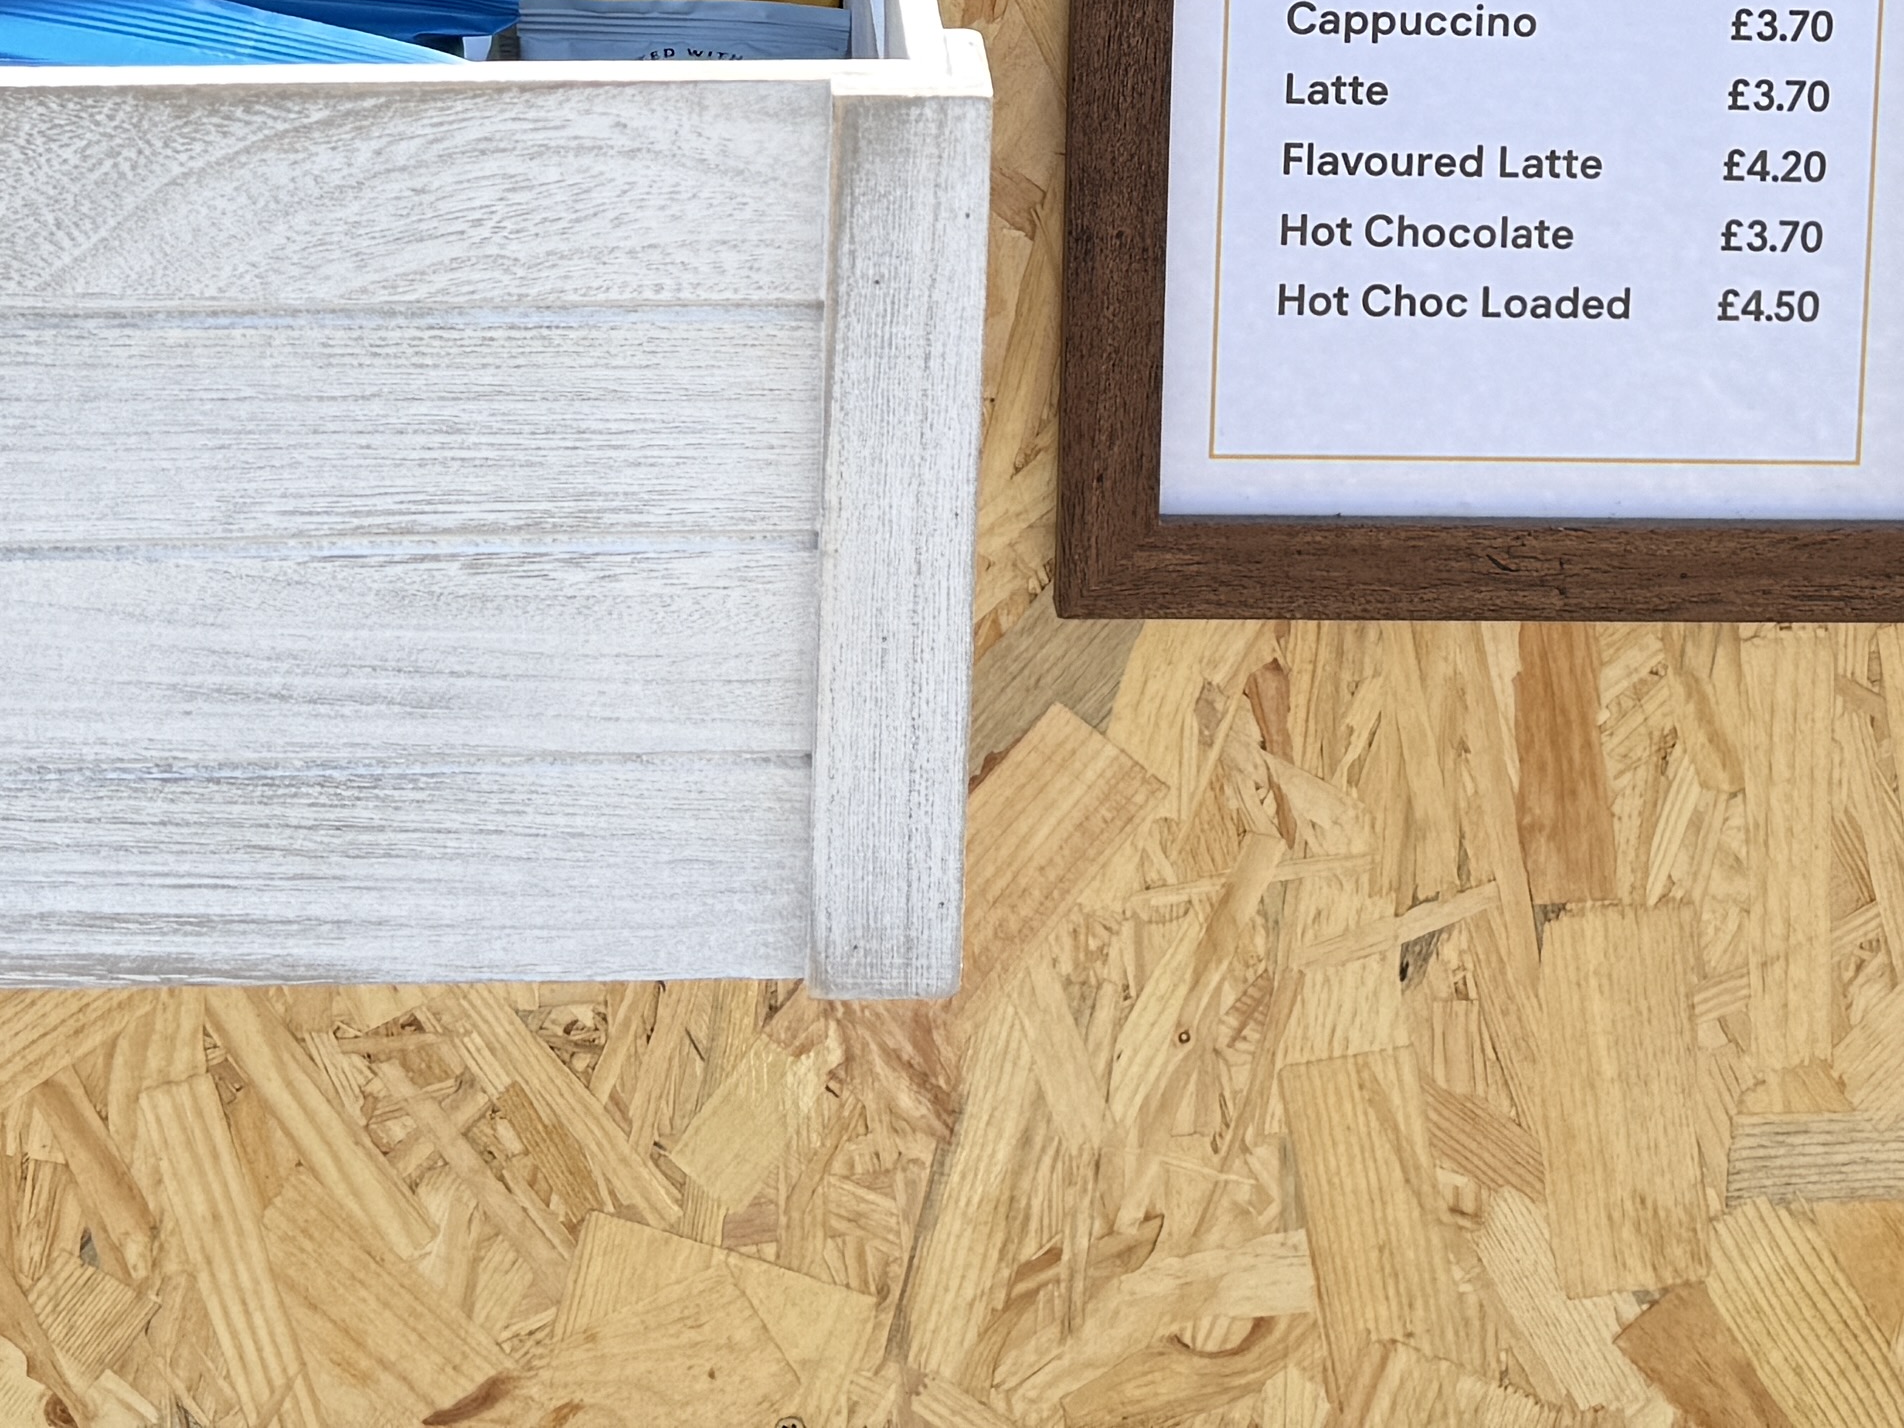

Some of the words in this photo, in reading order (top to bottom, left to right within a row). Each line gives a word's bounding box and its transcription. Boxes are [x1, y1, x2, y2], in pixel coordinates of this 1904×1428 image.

[1286, 1, 1538, 45] Cappuccino
[1730, 9, 1834, 45] £3.70
[1284, 73, 1389, 109] Latte
[1727, 79, 1831, 115] £3.70
[1281, 142, 1484, 181] Flavoured
[1498, 144, 1604, 182] Latte
[1722, 149, 1827, 185] £4.20
[1279, 213, 1352, 249] Hot
[1364, 213, 1575, 252] Chocolate
[1720, 220, 1824, 256] £3.70
[1277, 283, 1350, 319] Hot
[1361, 284, 1469, 320] Choc
[1481, 286, 1632, 322] Loaded
[1717, 289, 1821, 325] £4.50
